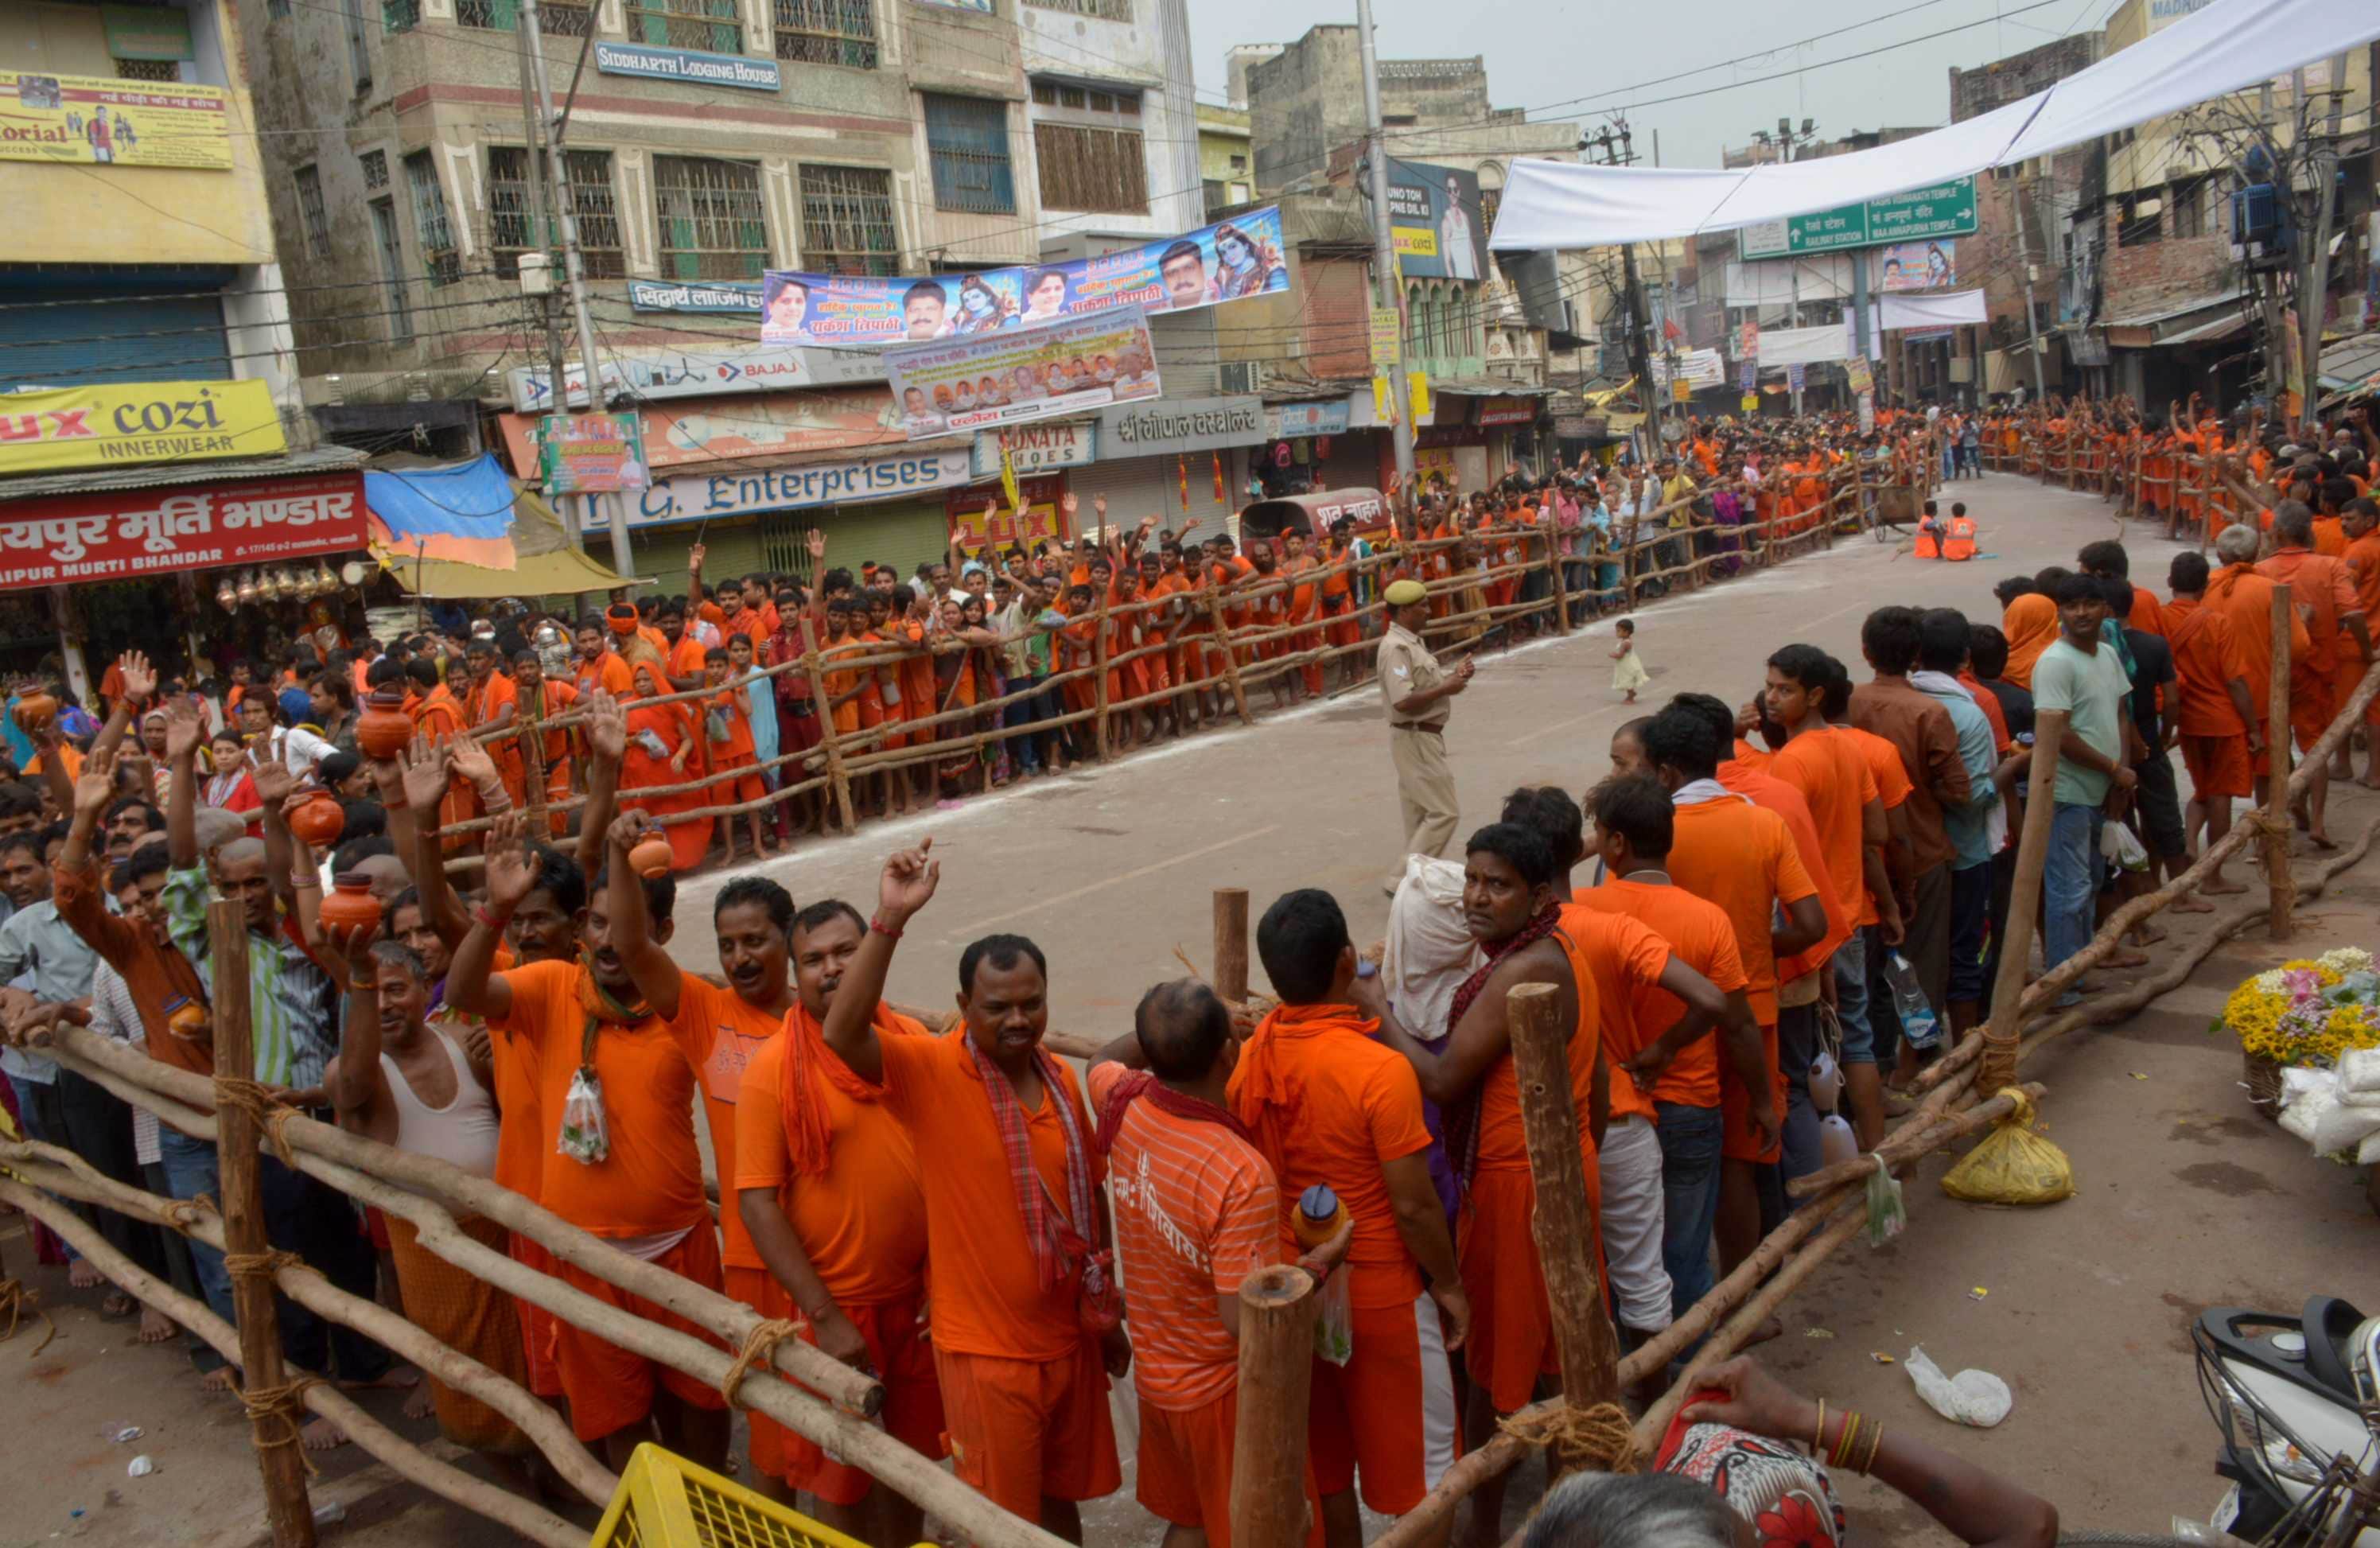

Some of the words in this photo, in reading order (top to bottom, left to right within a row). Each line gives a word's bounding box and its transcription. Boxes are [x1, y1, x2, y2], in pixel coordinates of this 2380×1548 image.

[598, 47, 678, 73] SIDDHARTH
[679, 56, 734, 80] LODGING
[734, 63, 777, 84] HOUSE
[0, 124, 68, 143] orial
[1387, 187, 1406, 199] UNO
[1389, 201, 1406, 213] PNE
[745, 363, 799, 376] BAJAJ
[113, 388, 224, 434] cozi
[99, 436, 235, 460] INNERWEAR
[704, 458, 940, 511] Enterprises
[0, 514, 112, 562] यपुर
[117, 495, 213, 552] मूर्ति
[221, 492, 355, 529] भण्डार
[962, 513, 1050, 547] LUX
[62, 559, 125, 578] MURTI
[131, 548, 223, 570] BHANDAR
